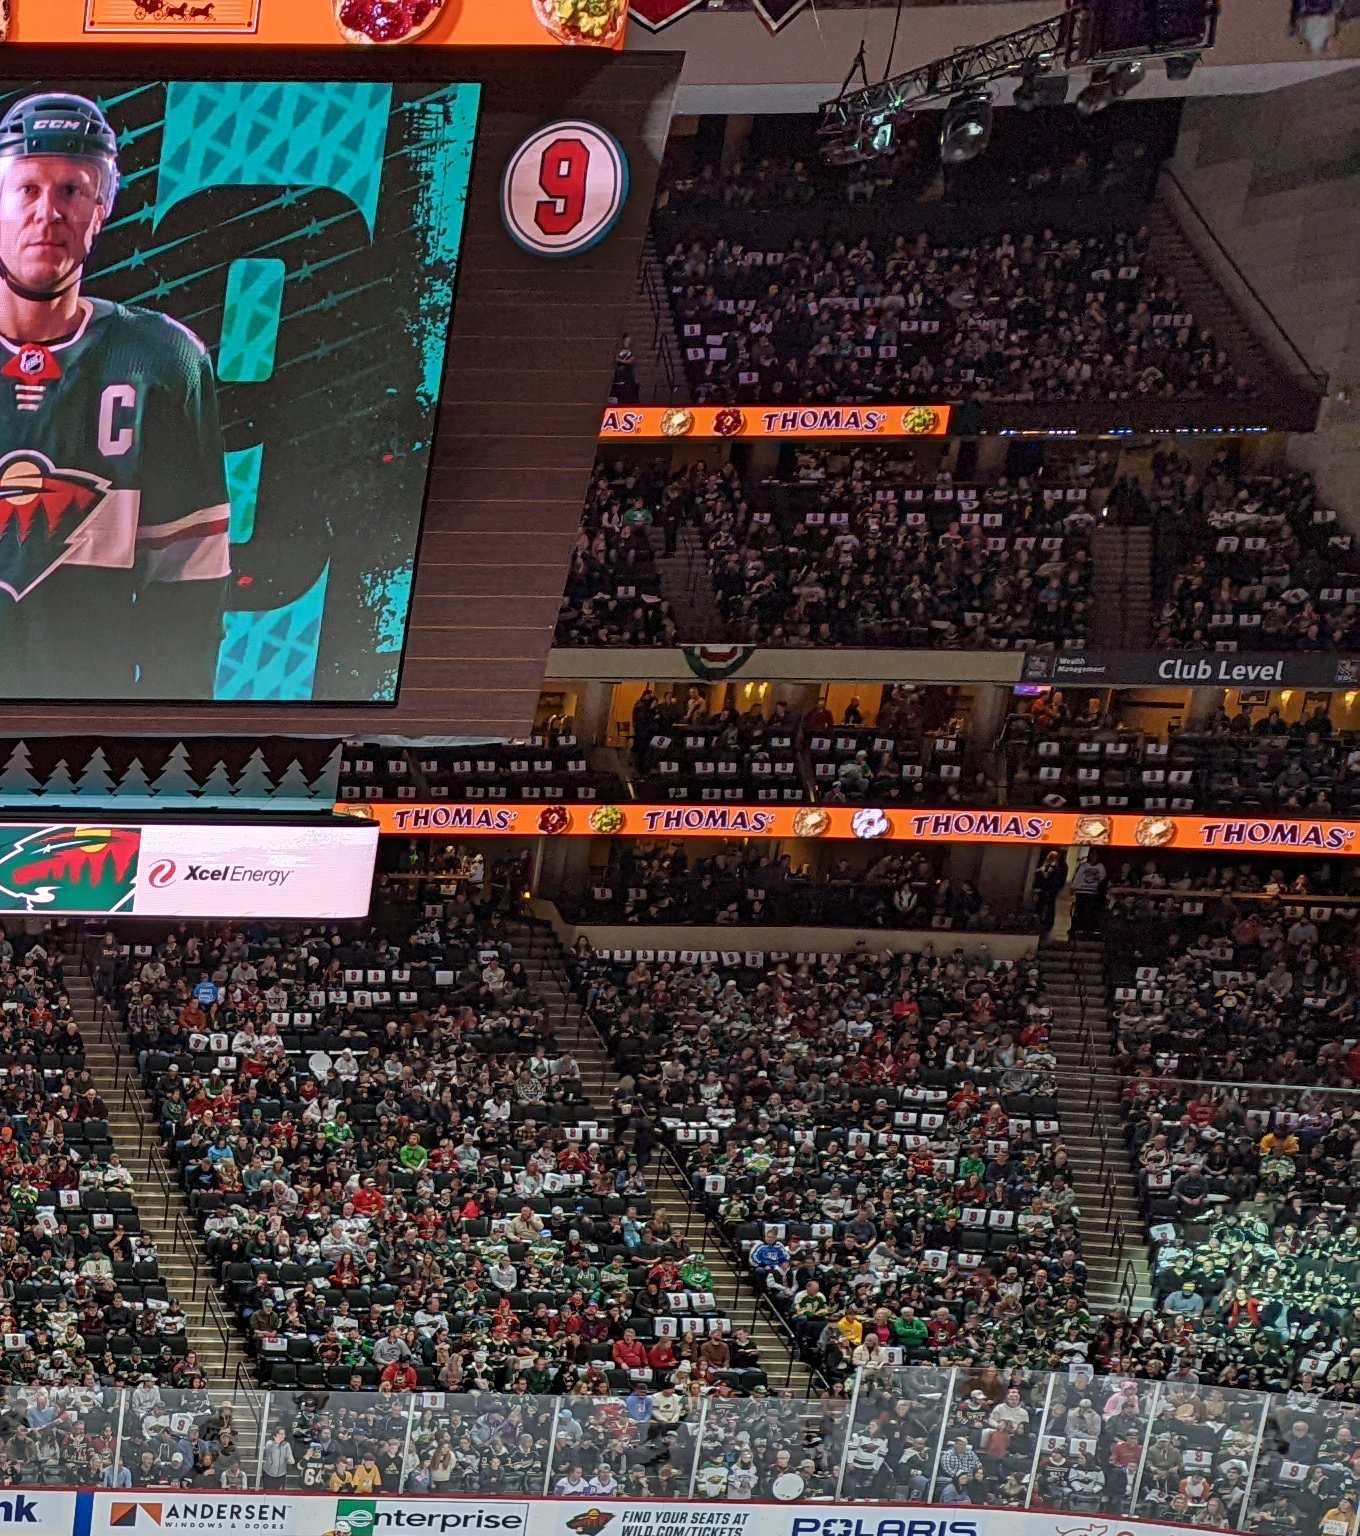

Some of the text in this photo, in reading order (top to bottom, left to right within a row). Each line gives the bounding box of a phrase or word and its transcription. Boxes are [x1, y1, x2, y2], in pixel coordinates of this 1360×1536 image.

[33, 119, 80, 131] CCM
[535, 138, 590, 236] 9
[98, 384, 136, 456] C
[1158, 658, 1284, 682] Club Level
[184, 864, 289, 887] Xcel Energy
[166, 1502, 287, 1521] ANDERSEN
[622, 1510, 750, 1526] FIND YOUR SEATS AT
[165, 1521, 224, 1530] WINDOWS
[245, 1523, 285, 1531] DOORS
